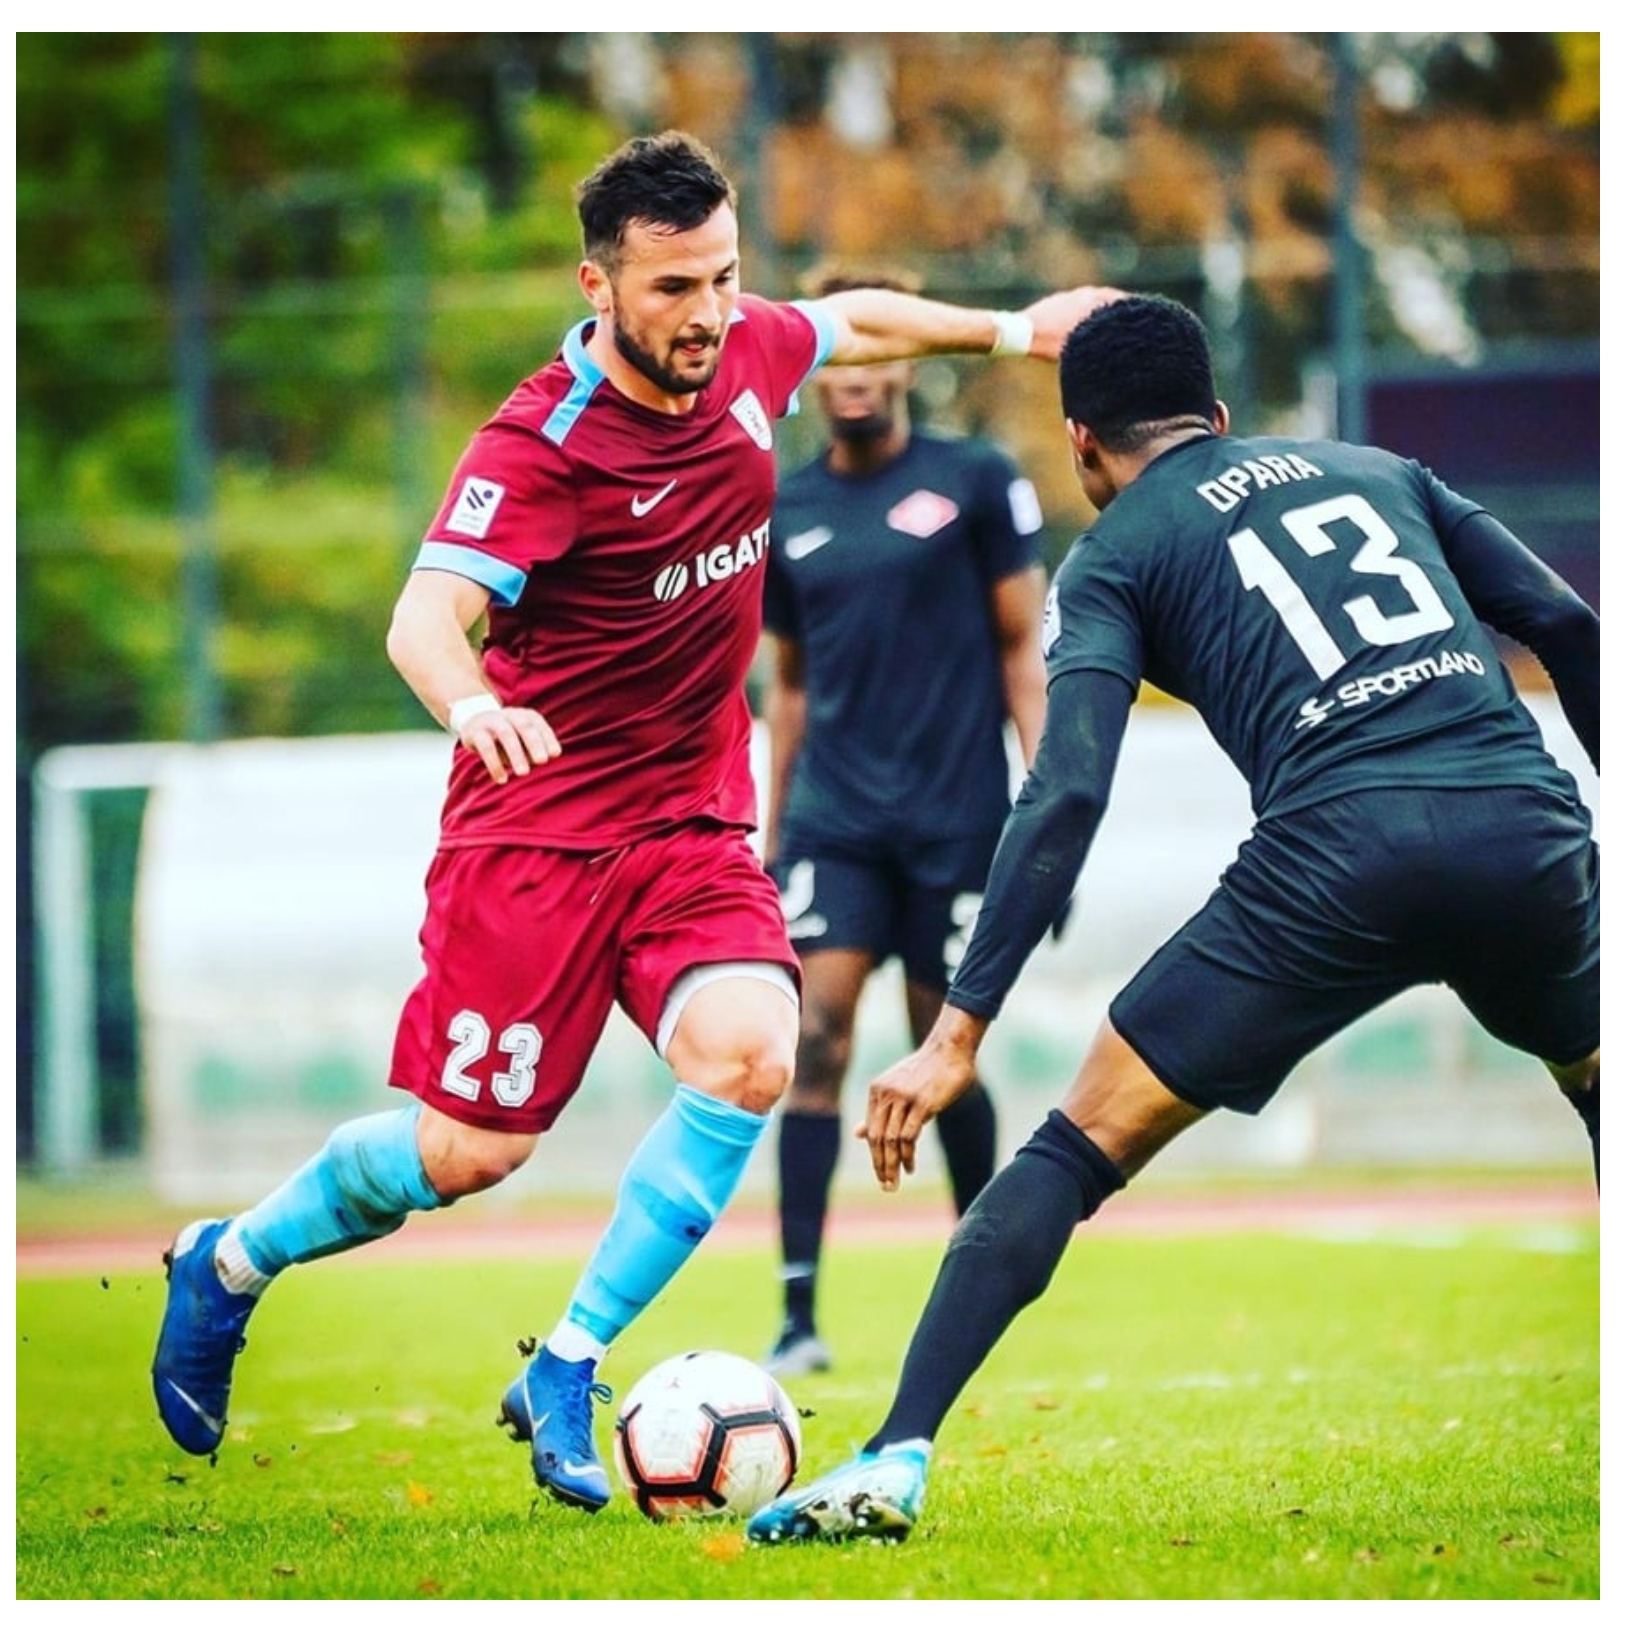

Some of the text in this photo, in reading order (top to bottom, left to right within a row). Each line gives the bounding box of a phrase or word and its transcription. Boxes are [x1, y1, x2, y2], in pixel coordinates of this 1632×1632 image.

[1196, 452, 1325, 513] OPARA
[1227, 493, 1455, 682] 13
[1337, 650, 1486, 708] SPORTLAND
[441, 1008, 544, 1108] 23
